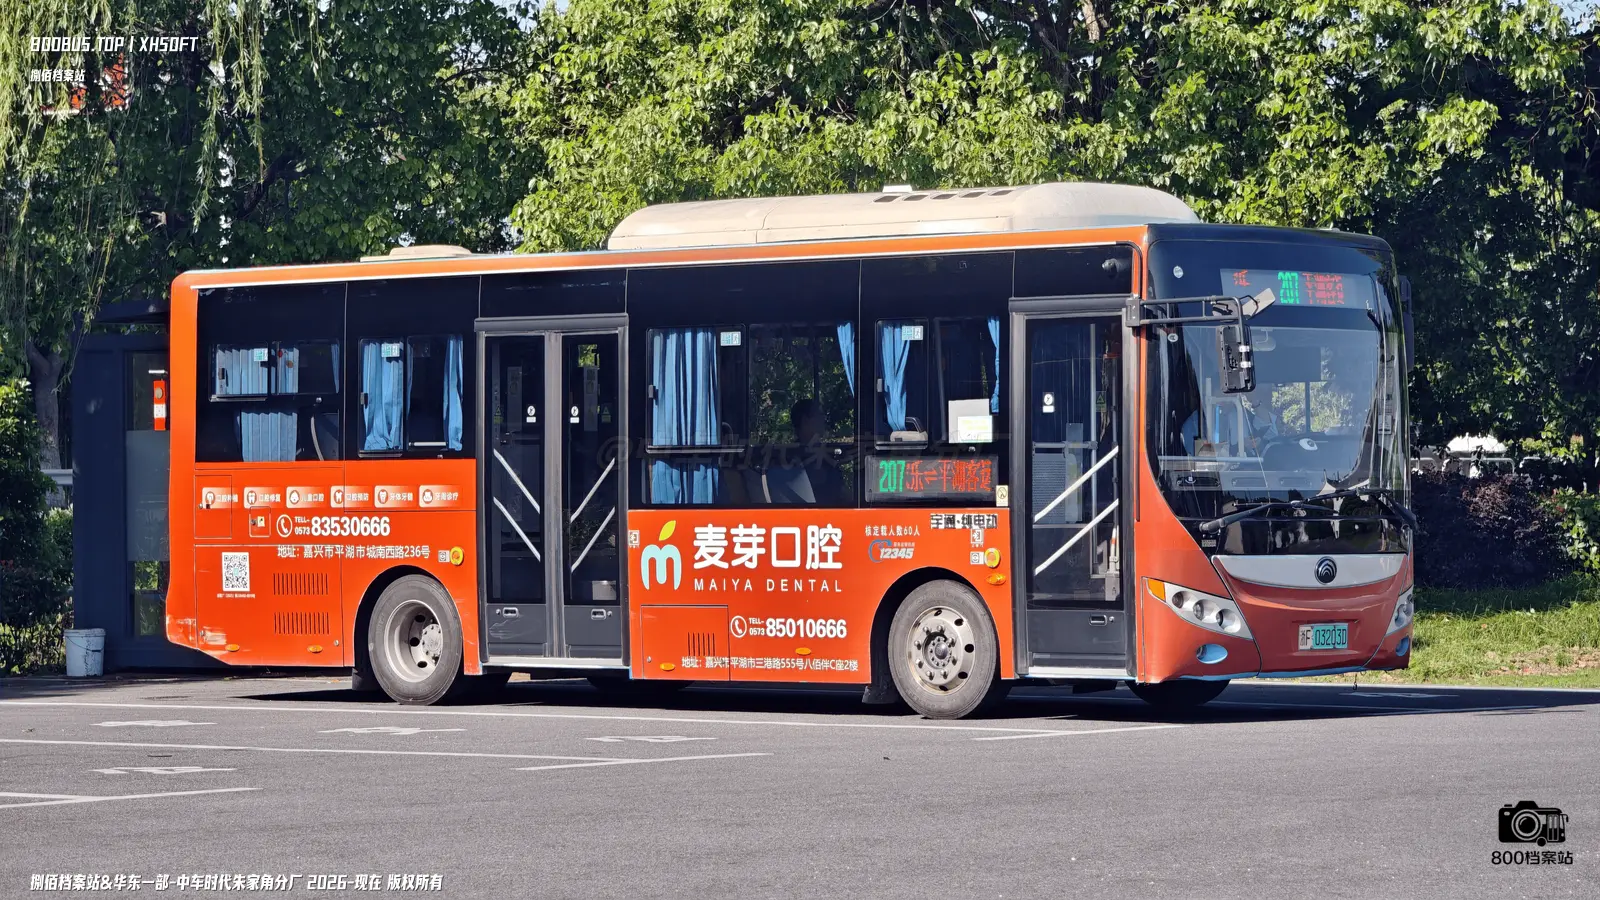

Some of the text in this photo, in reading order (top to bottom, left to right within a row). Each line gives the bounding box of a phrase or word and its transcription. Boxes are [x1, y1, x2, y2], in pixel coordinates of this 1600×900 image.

[294, 516, 391, 536] 0573 83530666
[865, 525, 920, 536] 核定载人数60人
[693, 523, 843, 570] 麦芽口腔
[880, 548, 914, 559] 12345
[694, 578, 842, 592] MAIYA DENTAL
[749, 618, 847, 638] 0573 85010666
